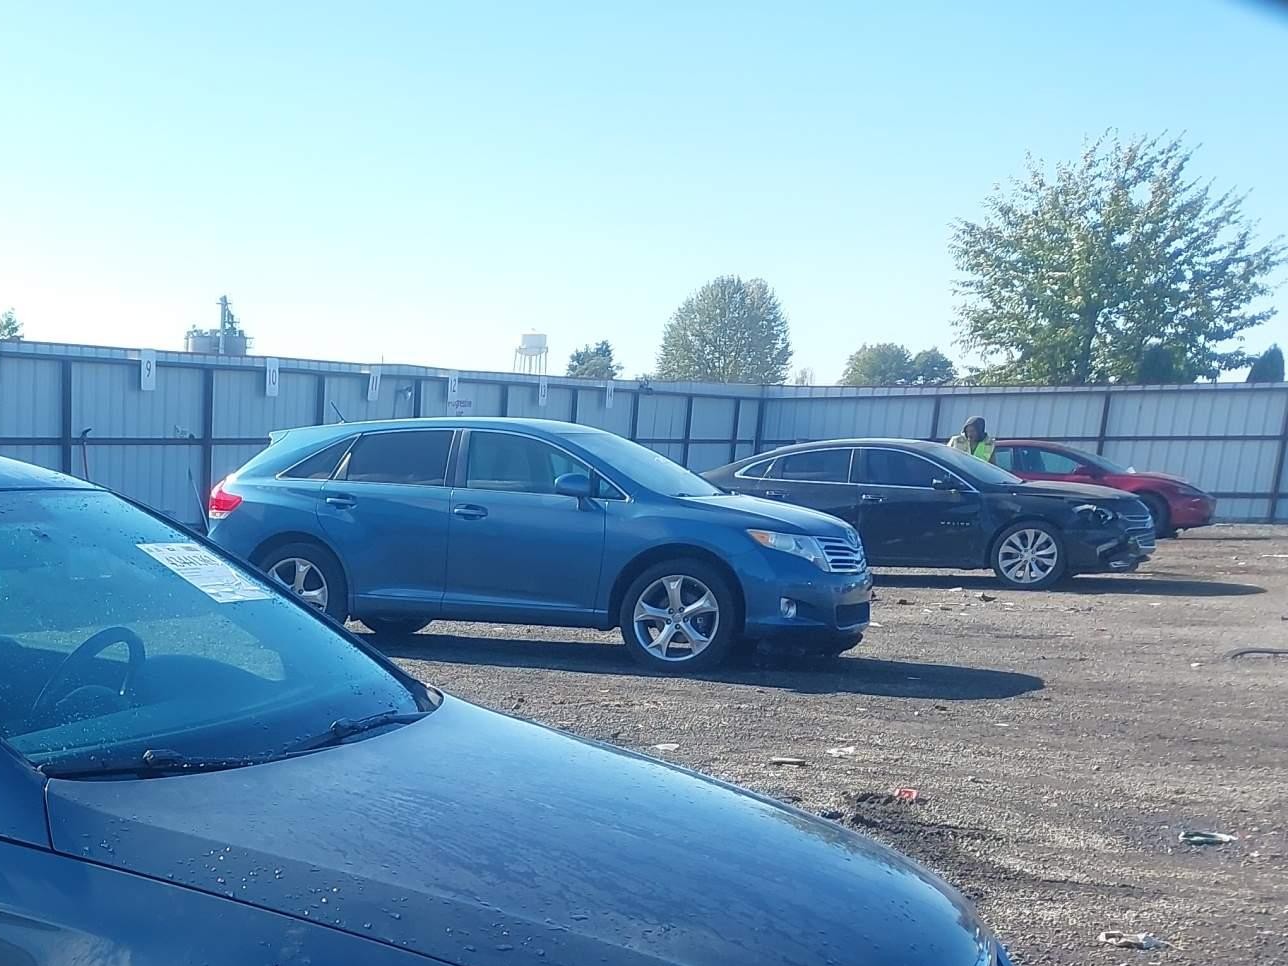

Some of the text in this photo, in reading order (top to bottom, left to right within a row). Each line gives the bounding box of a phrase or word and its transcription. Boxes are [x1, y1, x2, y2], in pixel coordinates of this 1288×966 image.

[145, 359, 152, 378] 9
[268, 368, 278, 386] 10
[371, 375, 379, 391] 11
[450, 378, 457, 393] 12
